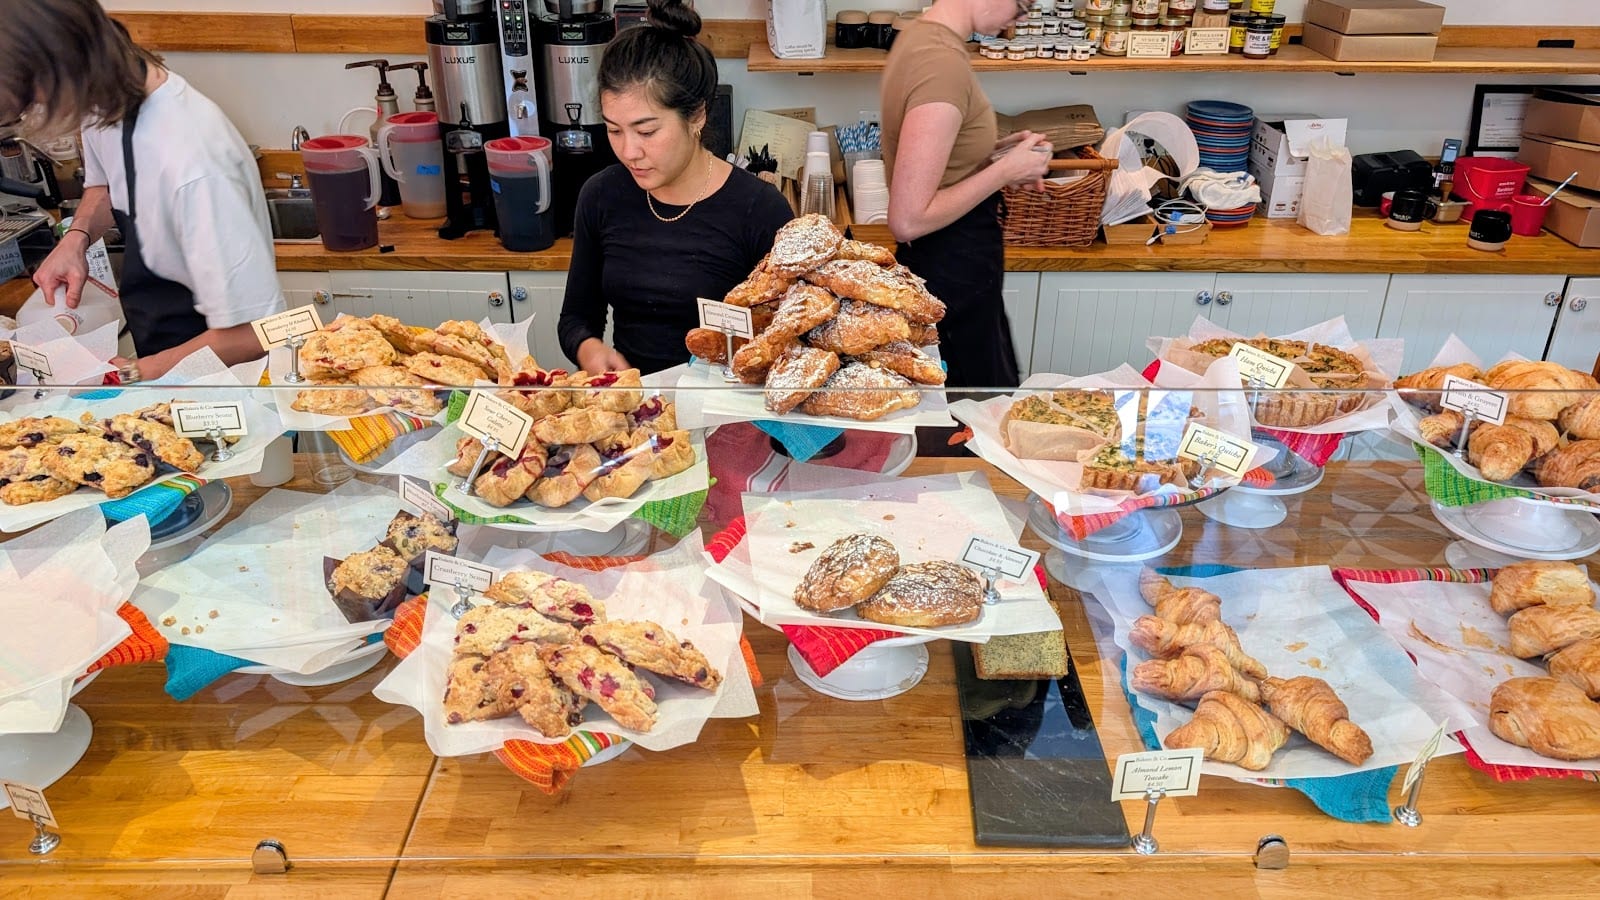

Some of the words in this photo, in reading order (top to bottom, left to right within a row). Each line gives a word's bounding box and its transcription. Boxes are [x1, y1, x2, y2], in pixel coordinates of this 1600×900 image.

[1239, 356, 1255, 365] Ham
[484, 405, 496, 414] Sour
[496, 411, 512, 426] Cherry
[1194, 436, 1217, 449] Baker's
[1218, 446, 1242, 458] Quiche
[434, 565, 468, 577] Cranberry
[469, 573, 489, 582] Scone
[1131, 766, 1159, 774] Almond
